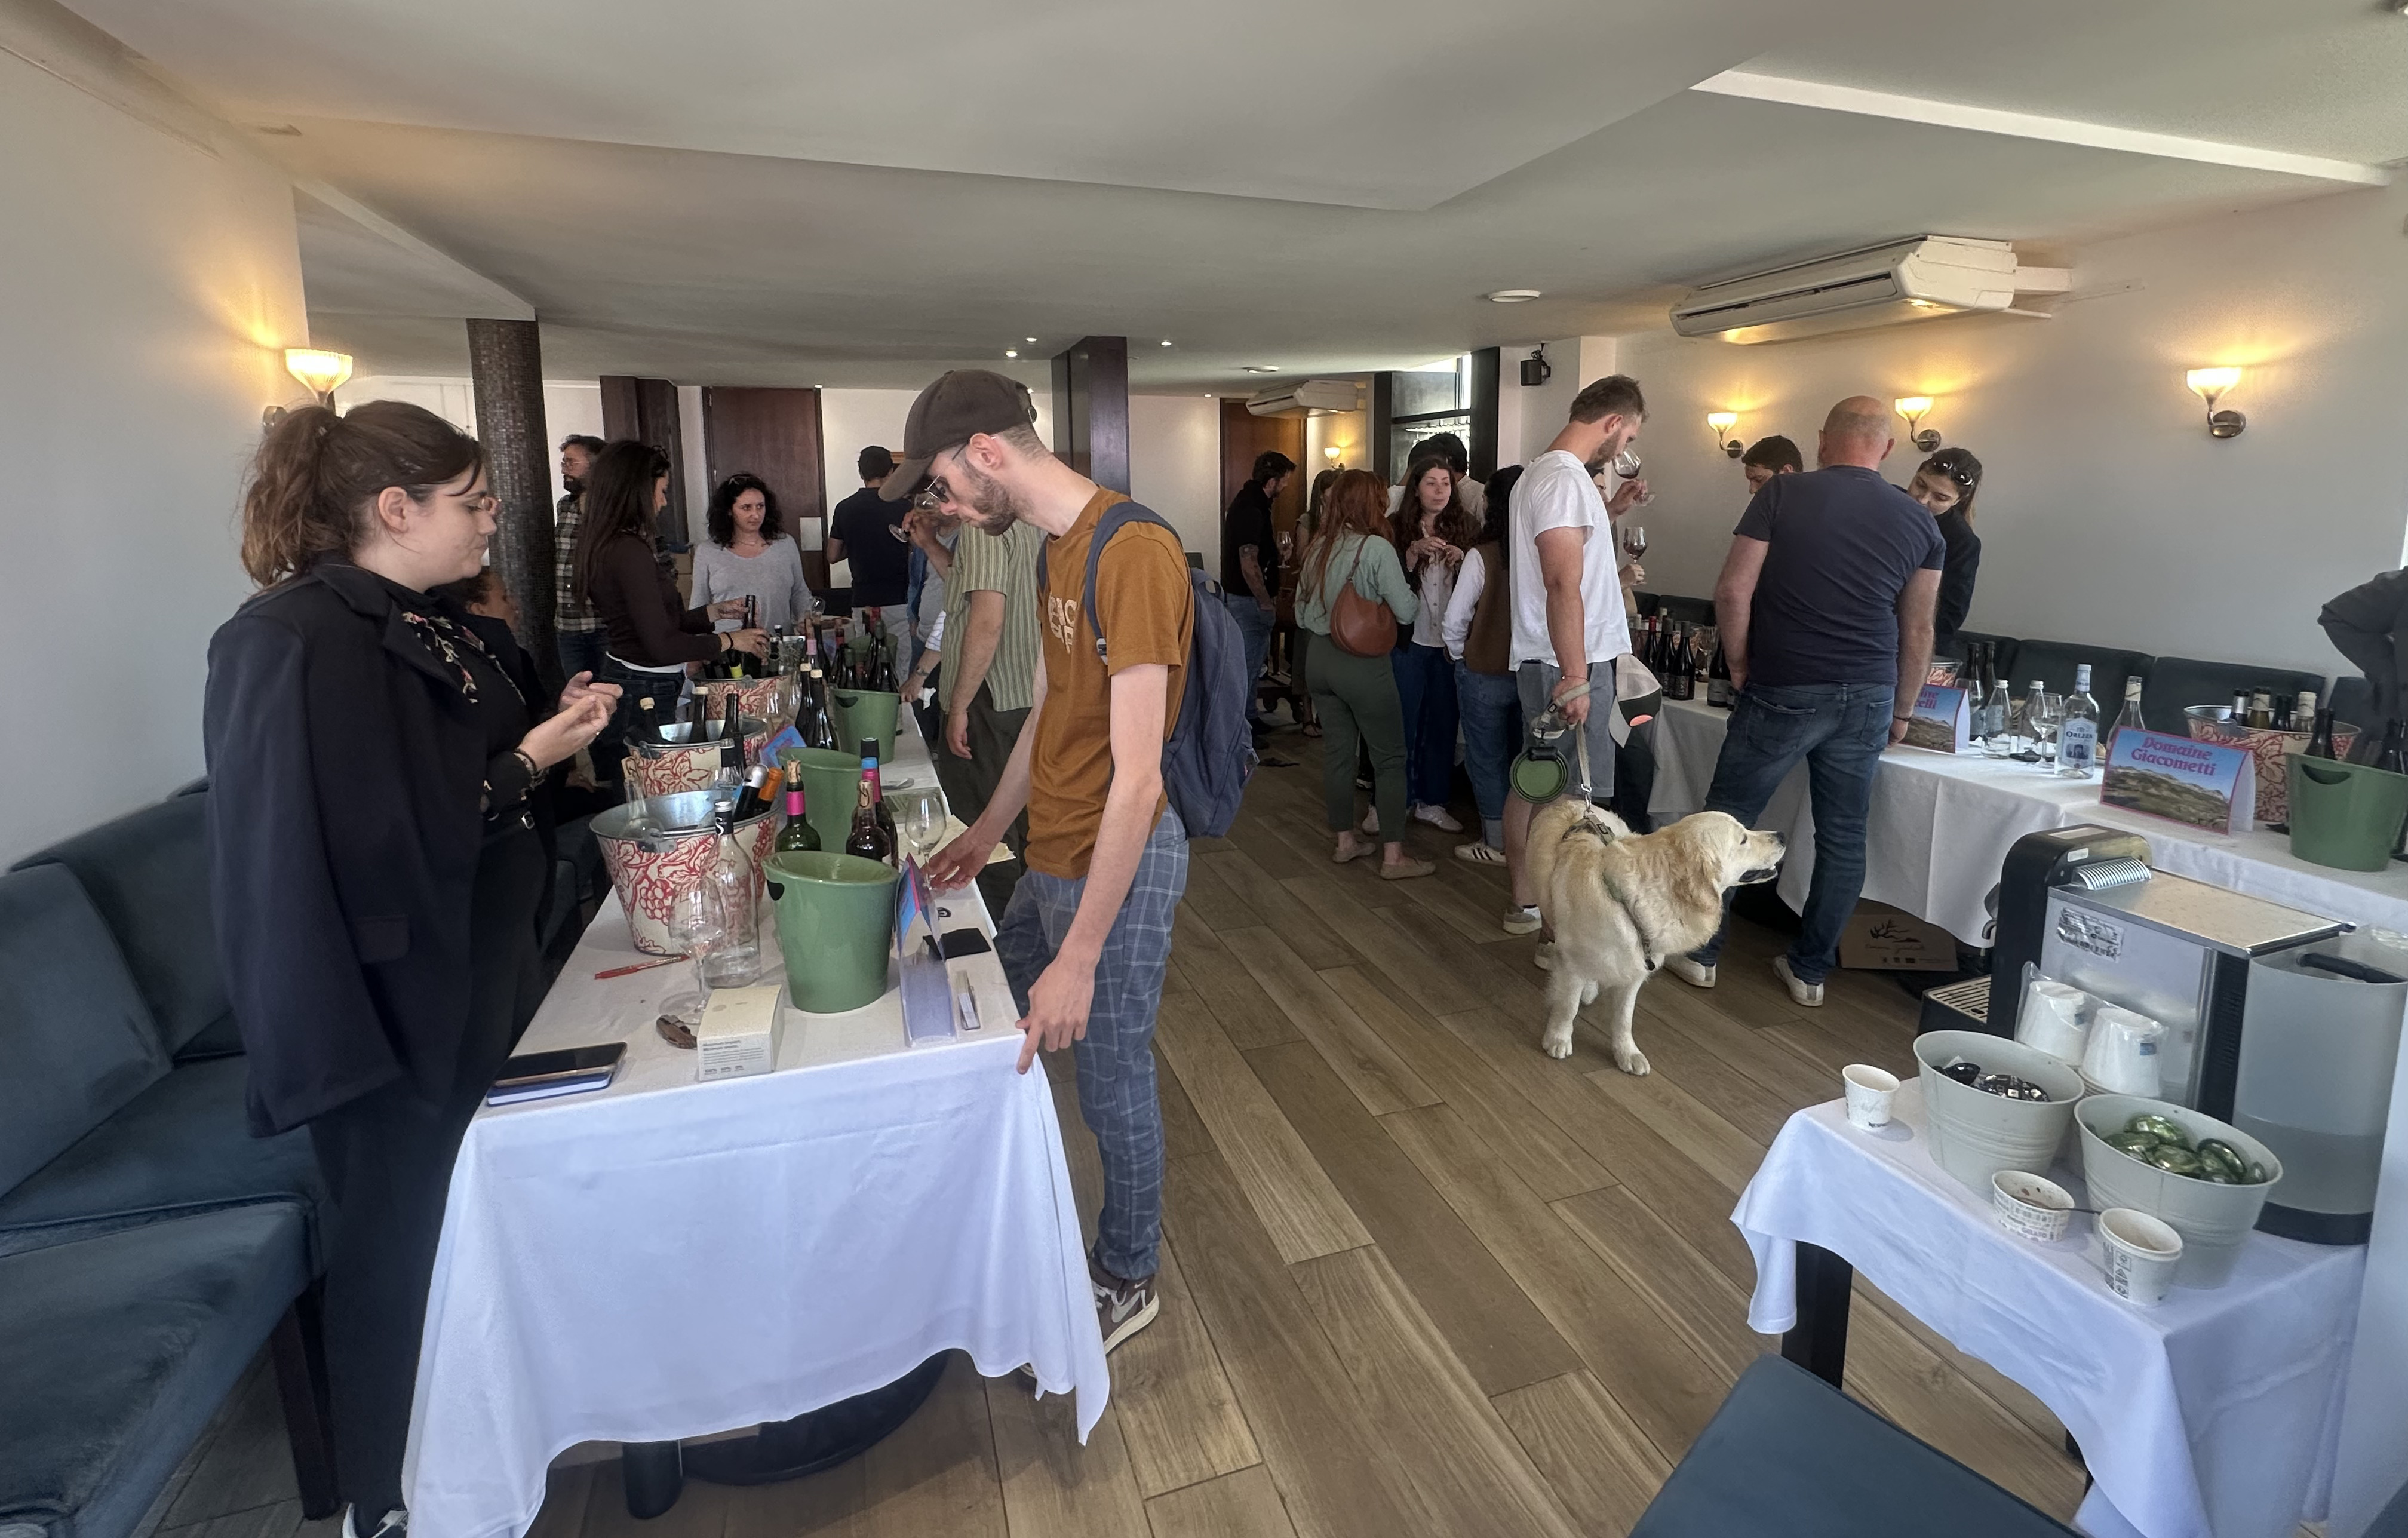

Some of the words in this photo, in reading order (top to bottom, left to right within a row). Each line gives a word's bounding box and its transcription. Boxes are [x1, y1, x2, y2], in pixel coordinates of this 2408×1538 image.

[1916, 699, 1937, 710] elli
[2141, 736, 2213, 760] Domaine
[2131, 748, 2217, 776] Giacometti
